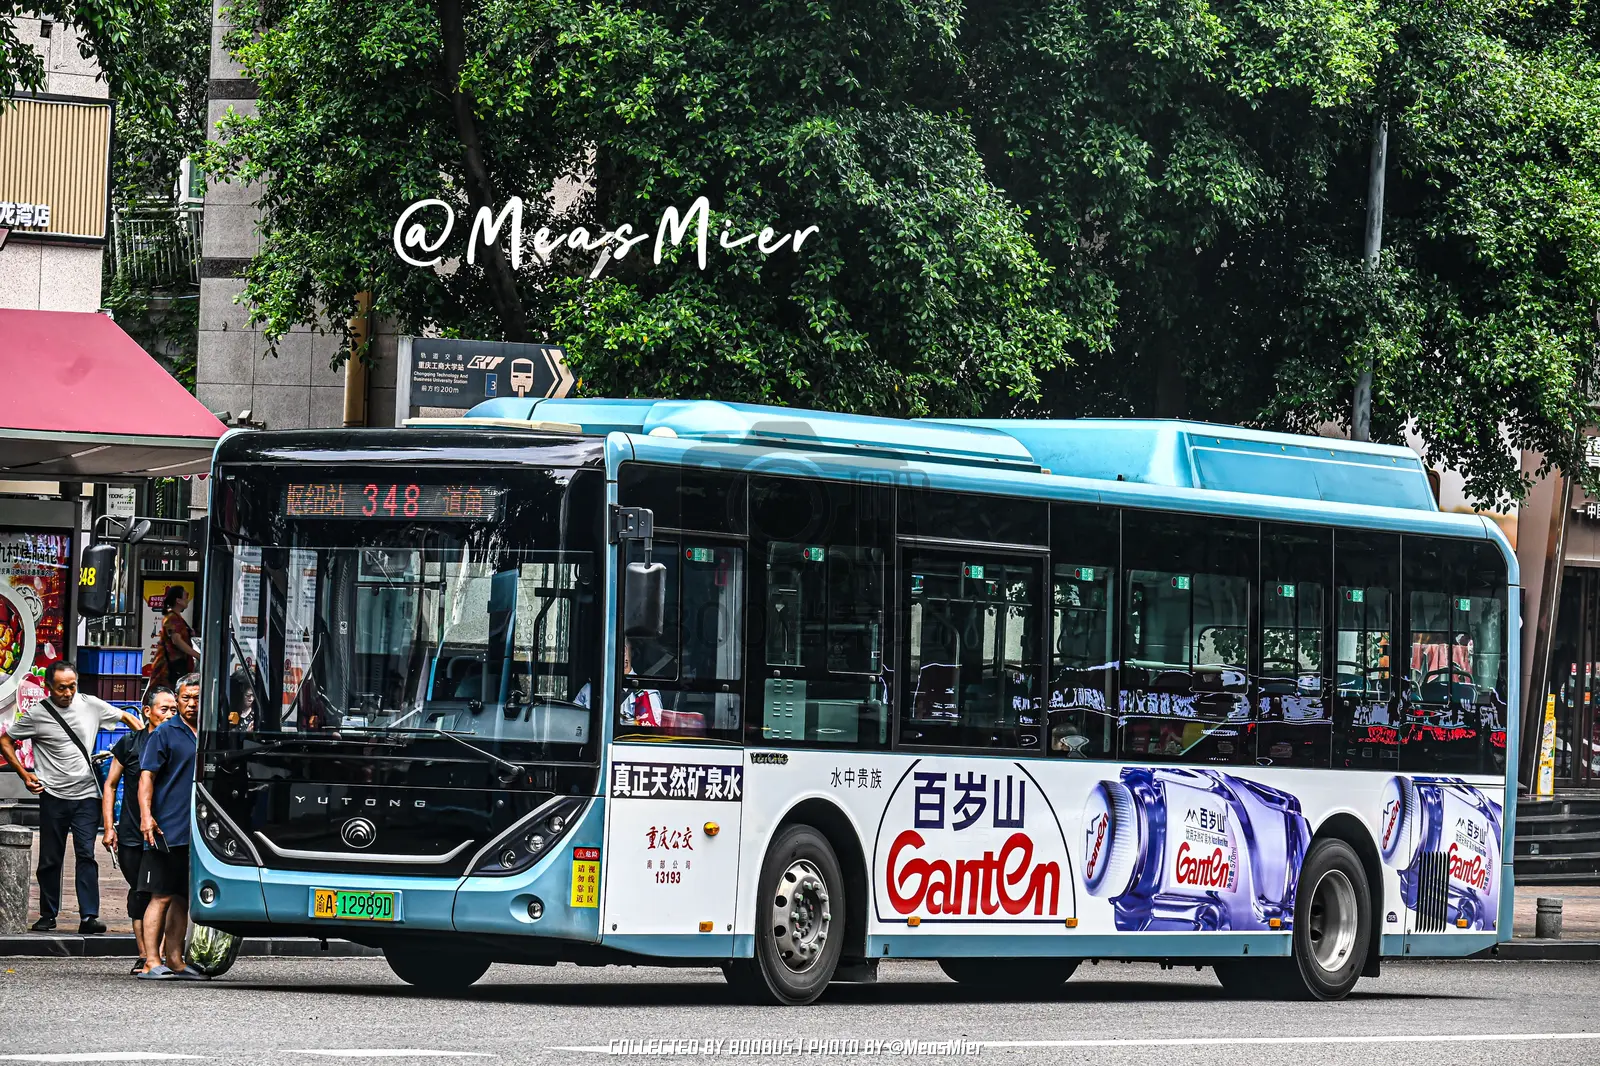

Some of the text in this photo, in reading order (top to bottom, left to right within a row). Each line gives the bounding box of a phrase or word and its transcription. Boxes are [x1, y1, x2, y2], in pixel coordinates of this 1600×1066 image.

[418, 361, 464, 371] 重庆工商大学站
[420, 352, 463, 361] 轨道交通
[413, 371, 436, 379] Chongqing
[490, 381, 496, 391] 3
[421, 385, 459, 393] 前方约200m
[362, 484, 420, 517] 348
[612, 763, 742, 800] 真正天然矿泉水
[830, 766, 882, 789] 水中贵族
[295, 795, 426, 808] YUTONG
[913, 771, 1026, 831] 百岁山
[1200, 807, 1225, 833] 百岁山
[645, 826, 694, 851] 重庆公交
[886, 829, 1061, 916] Ganten
[1176, 841, 1230, 888] Ganten
[576, 864, 585, 903] 请勿靠近
[655, 871, 681, 884] 13193
